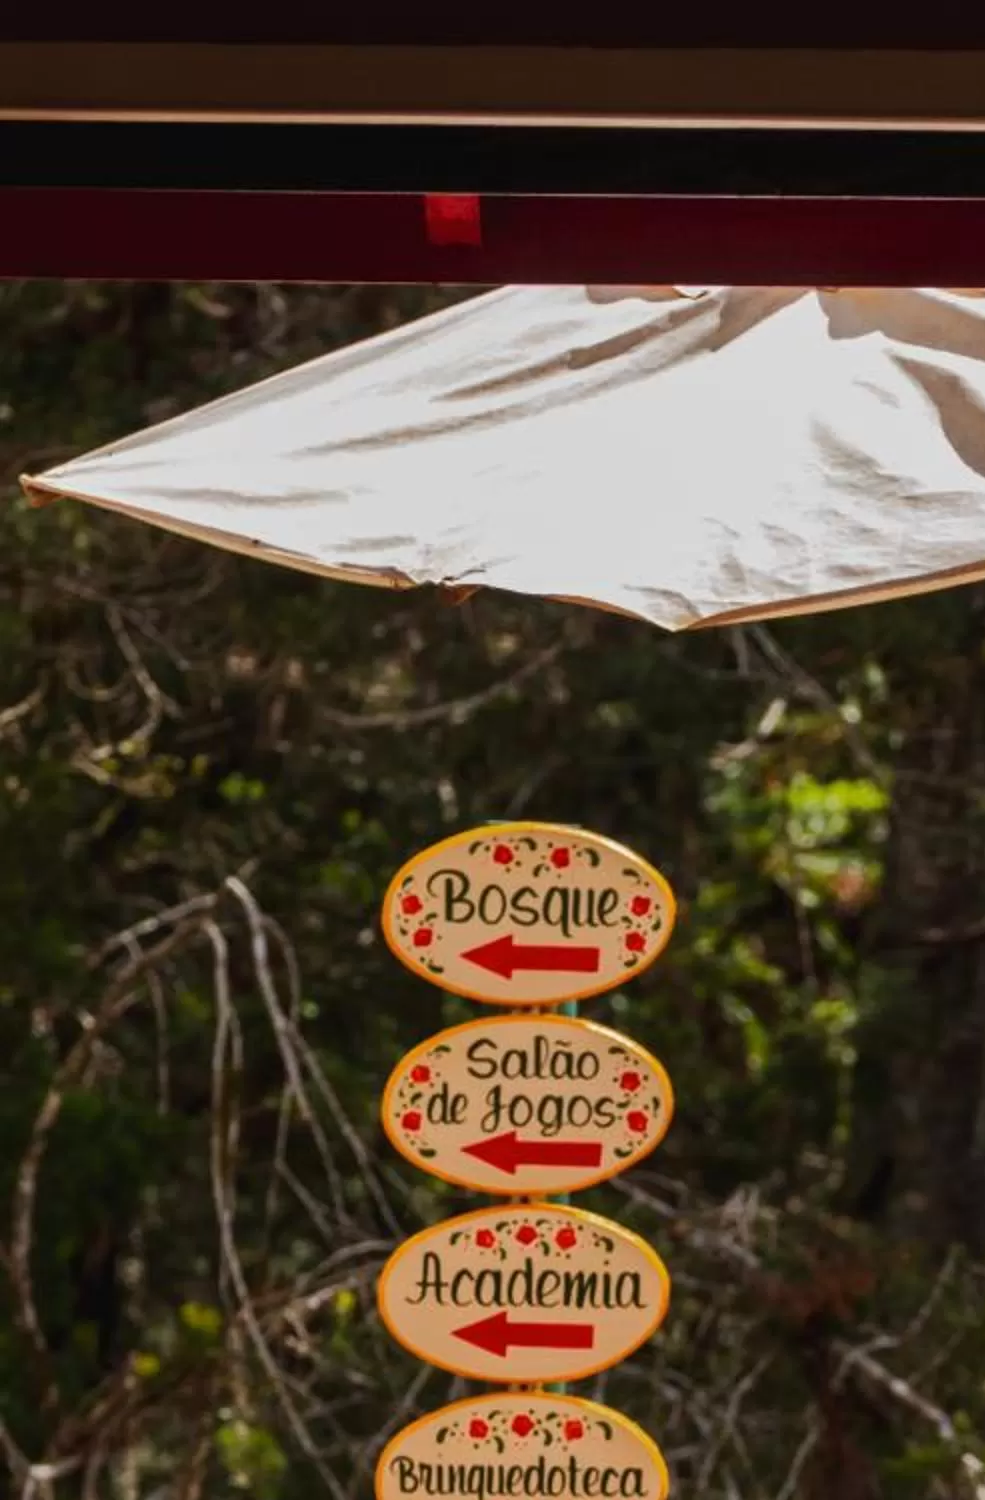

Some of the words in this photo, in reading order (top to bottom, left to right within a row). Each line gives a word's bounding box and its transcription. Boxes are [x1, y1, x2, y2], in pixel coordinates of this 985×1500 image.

[426, 868, 619, 939] Bosque
[466, 1034, 600, 1081] Salão
[426, 1082, 469, 1126] de
[479, 1084, 617, 1138] Jogos
[404, 1251, 649, 1310] Academia
